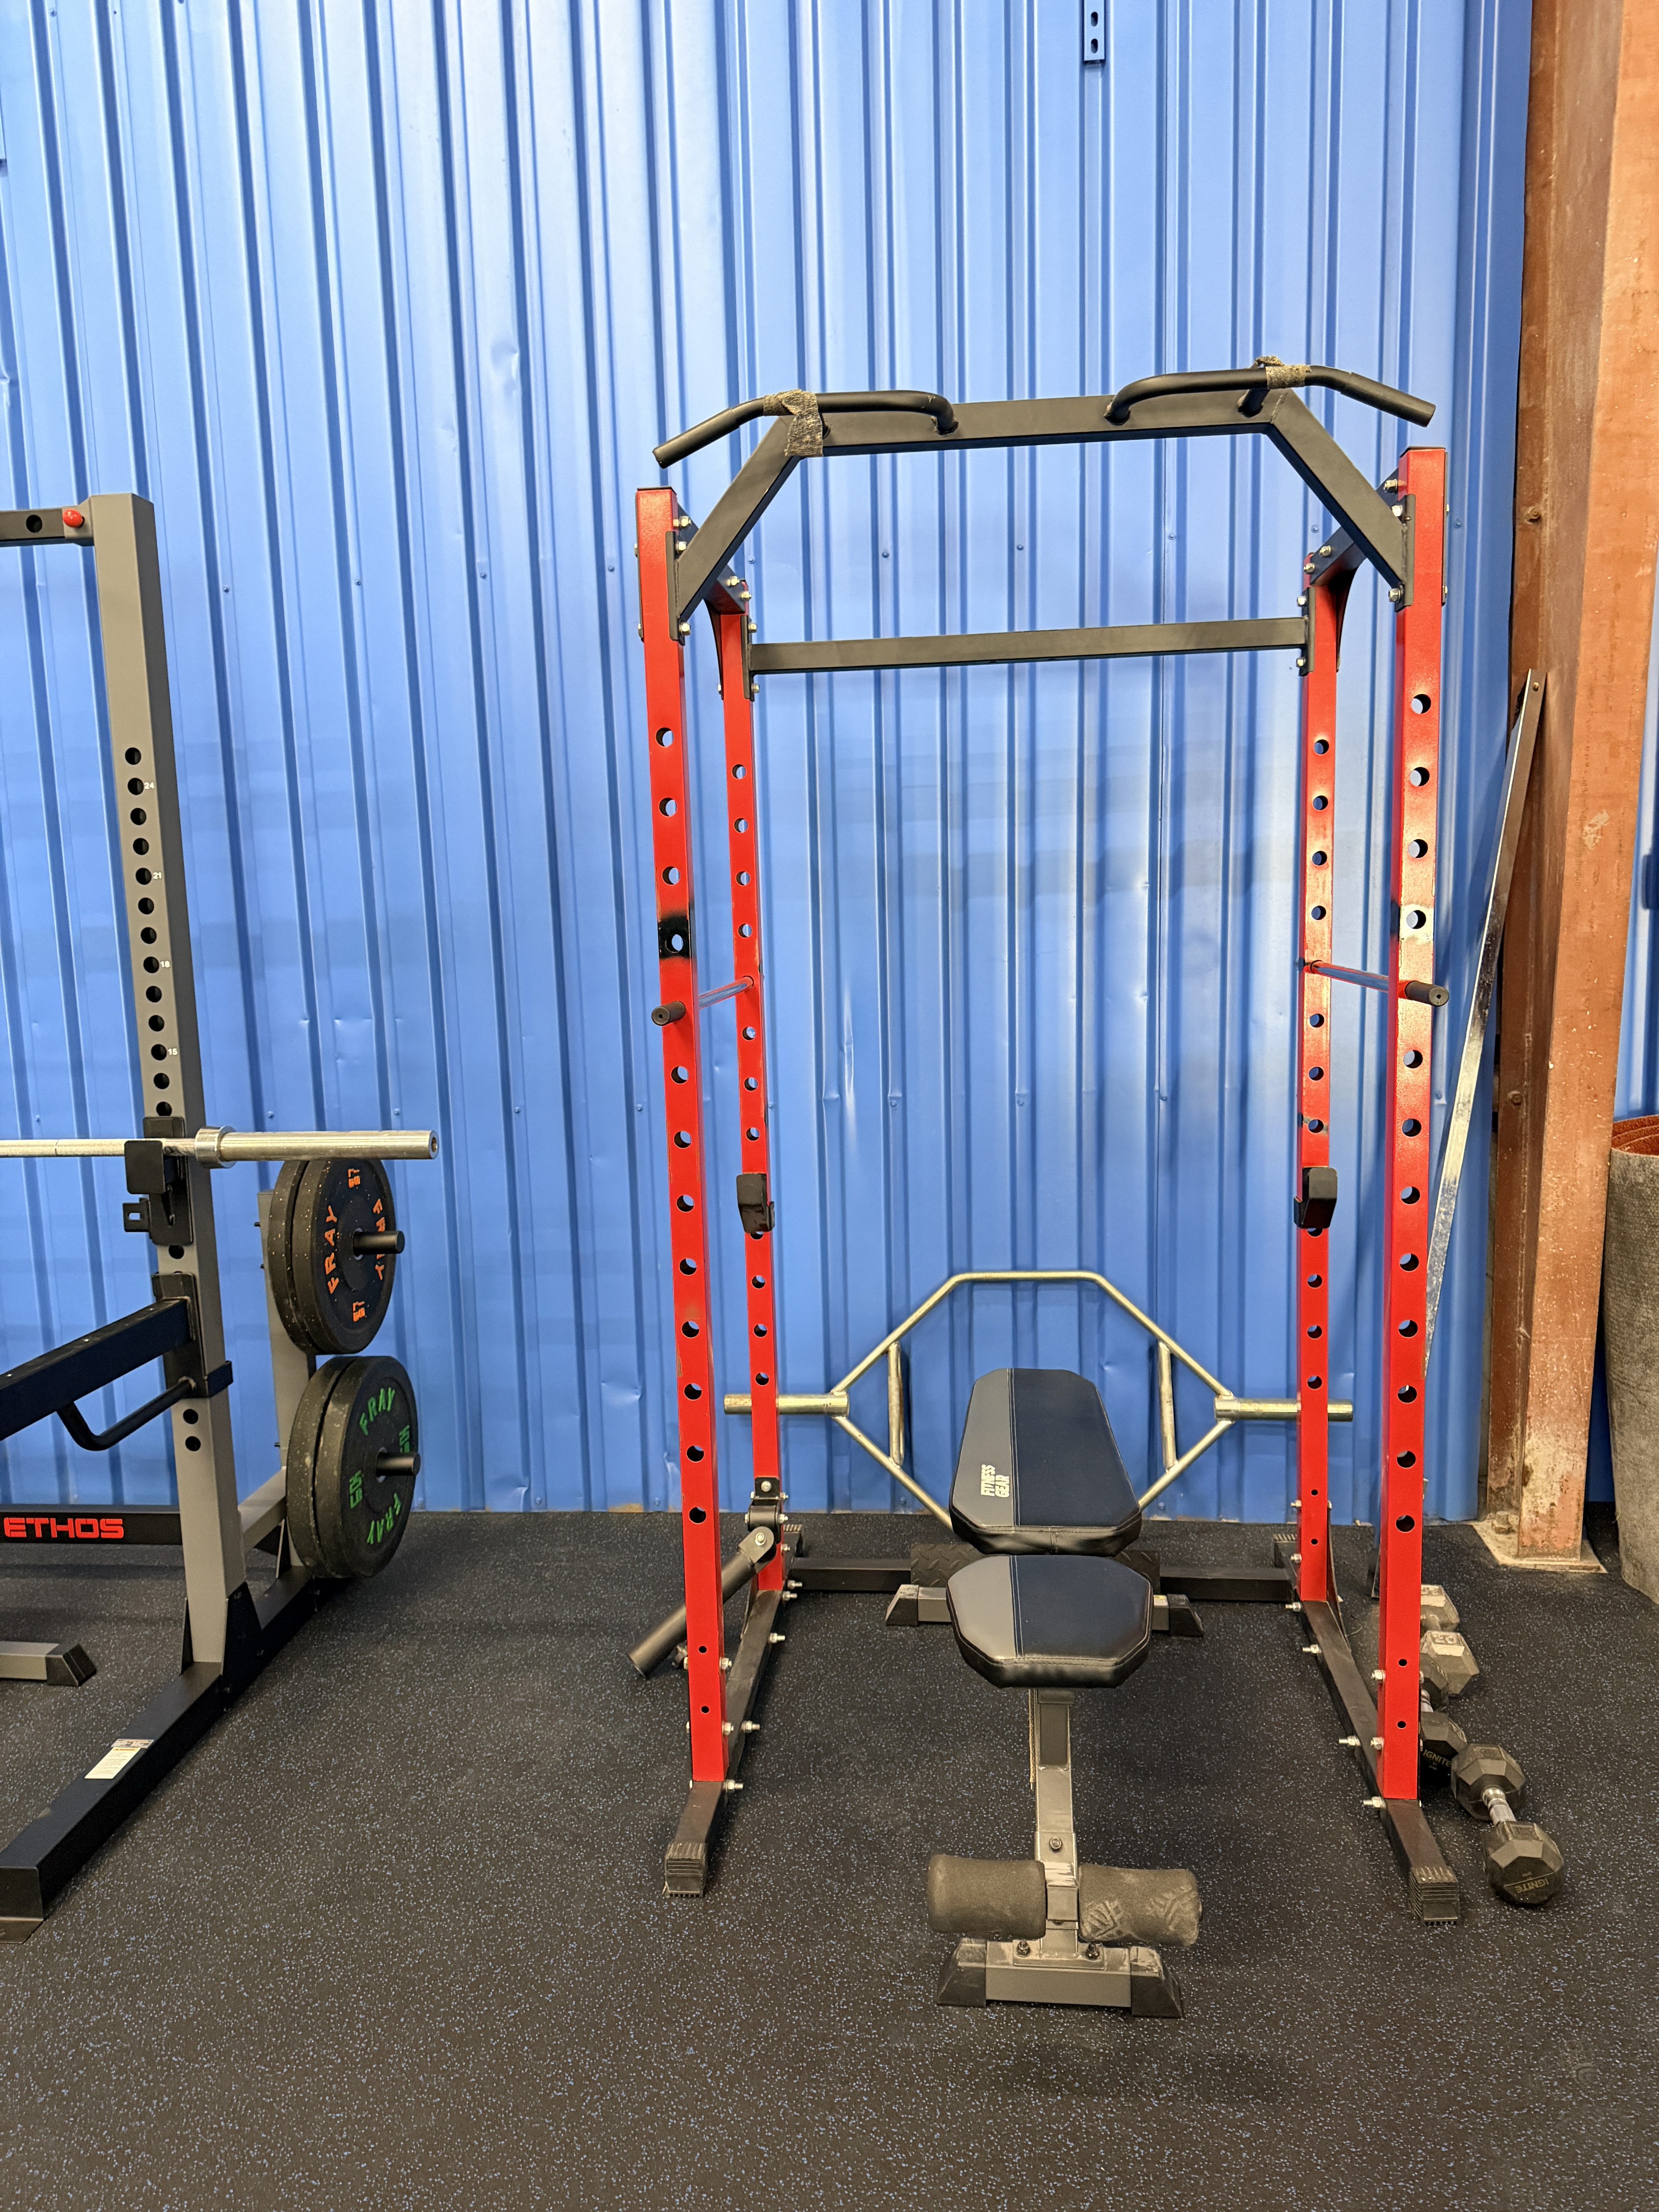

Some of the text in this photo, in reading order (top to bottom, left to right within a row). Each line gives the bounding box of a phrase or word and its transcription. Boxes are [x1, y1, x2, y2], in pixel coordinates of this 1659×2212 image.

[325, 1206, 339, 1294] FRAY
[373, 1199, 385, 1280] FRY
[359, 1388, 395, 1435] FRAY
[981, 1464, 996, 1496] FITNESS
[995, 1475, 1010, 1498] GEAR
[3, 1517, 124, 1539] ETHOS
[367, 1494, 401, 1544] FRAY
[1433, 1634, 1457, 1644] 20
[1423, 1749, 1452, 1768] IGNITE
[1515, 1878, 1549, 1893] IGNITE
